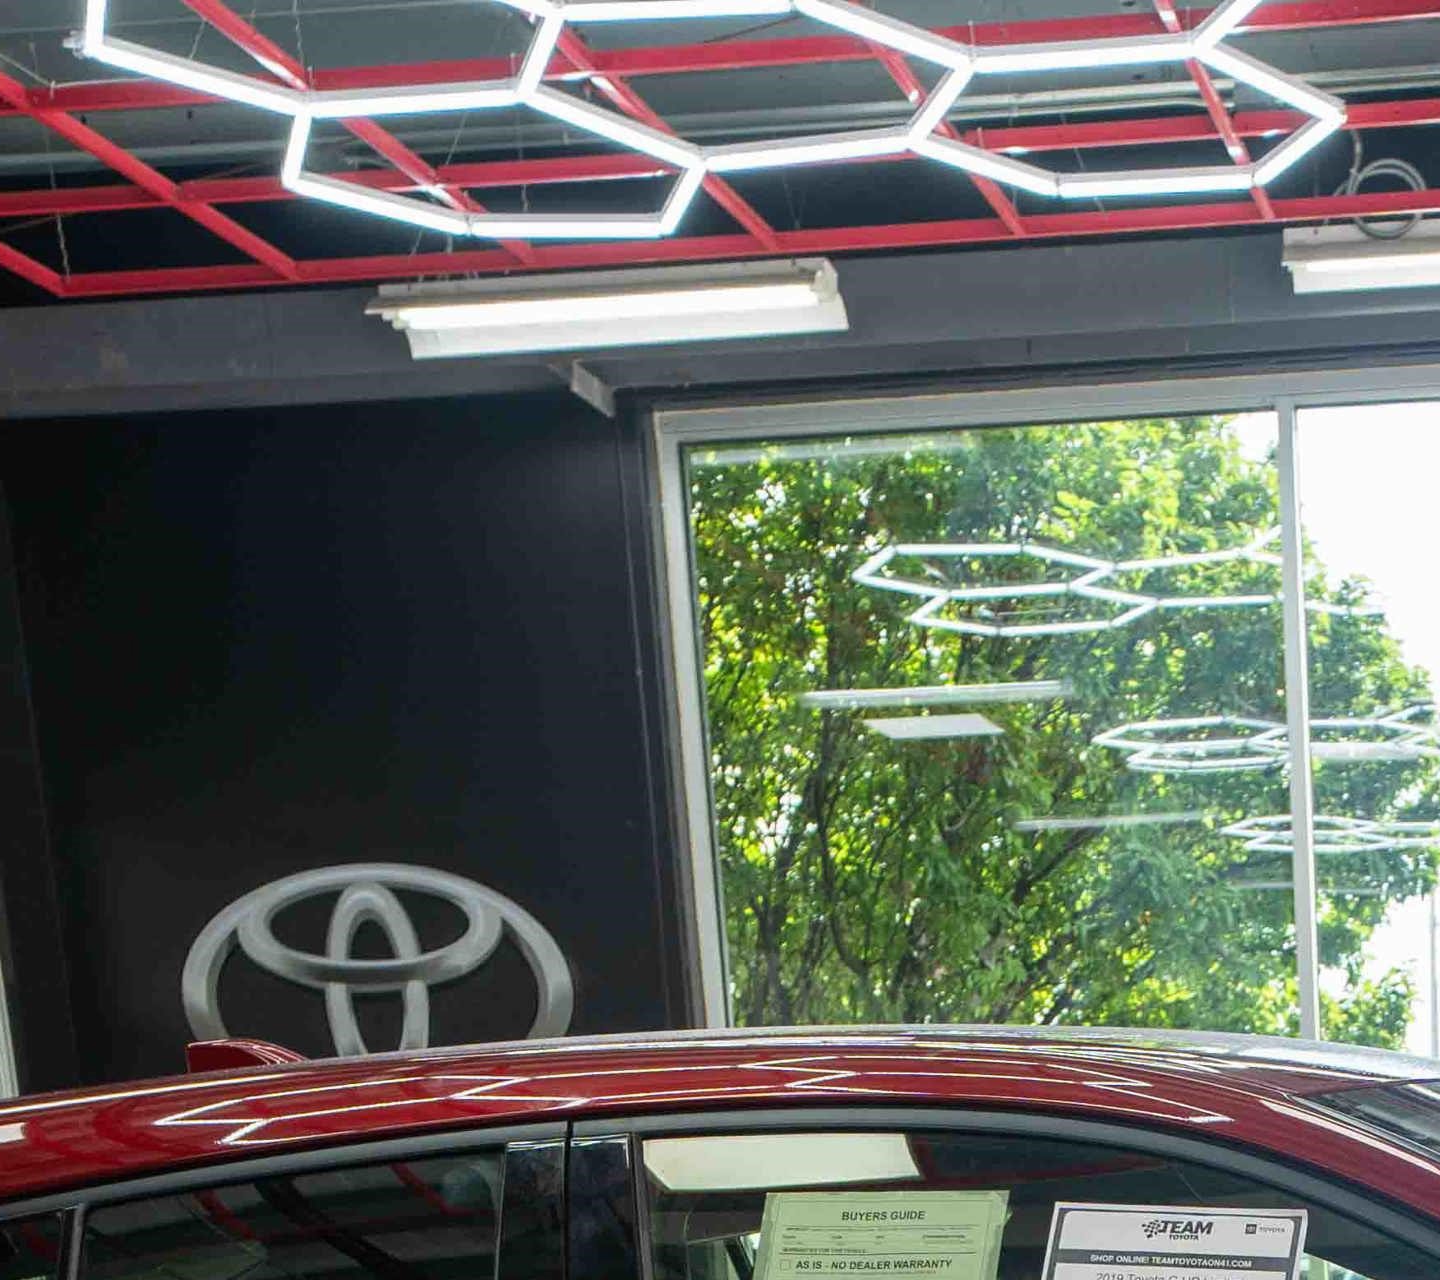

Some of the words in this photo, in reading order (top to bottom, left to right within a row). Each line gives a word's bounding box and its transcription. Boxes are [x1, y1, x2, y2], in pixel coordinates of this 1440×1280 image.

[841, 1210, 888, 1222] BUYERS
[890, 1210, 926, 1221] GUIDE
[1158, 1220, 1214, 1236] TEAM
[795, 1260, 810, 1270] AS
[812, 1260, 823, 1270] IS
[831, 1260, 847, 1270] NO
[849, 1260, 891, 1270] DEALER
[893, 1259, 953, 1270] WARRANTY
[1090, 1254, 1114, 1263] SHOP
[1115, 1255, 1150, 1265] ONLINE!
